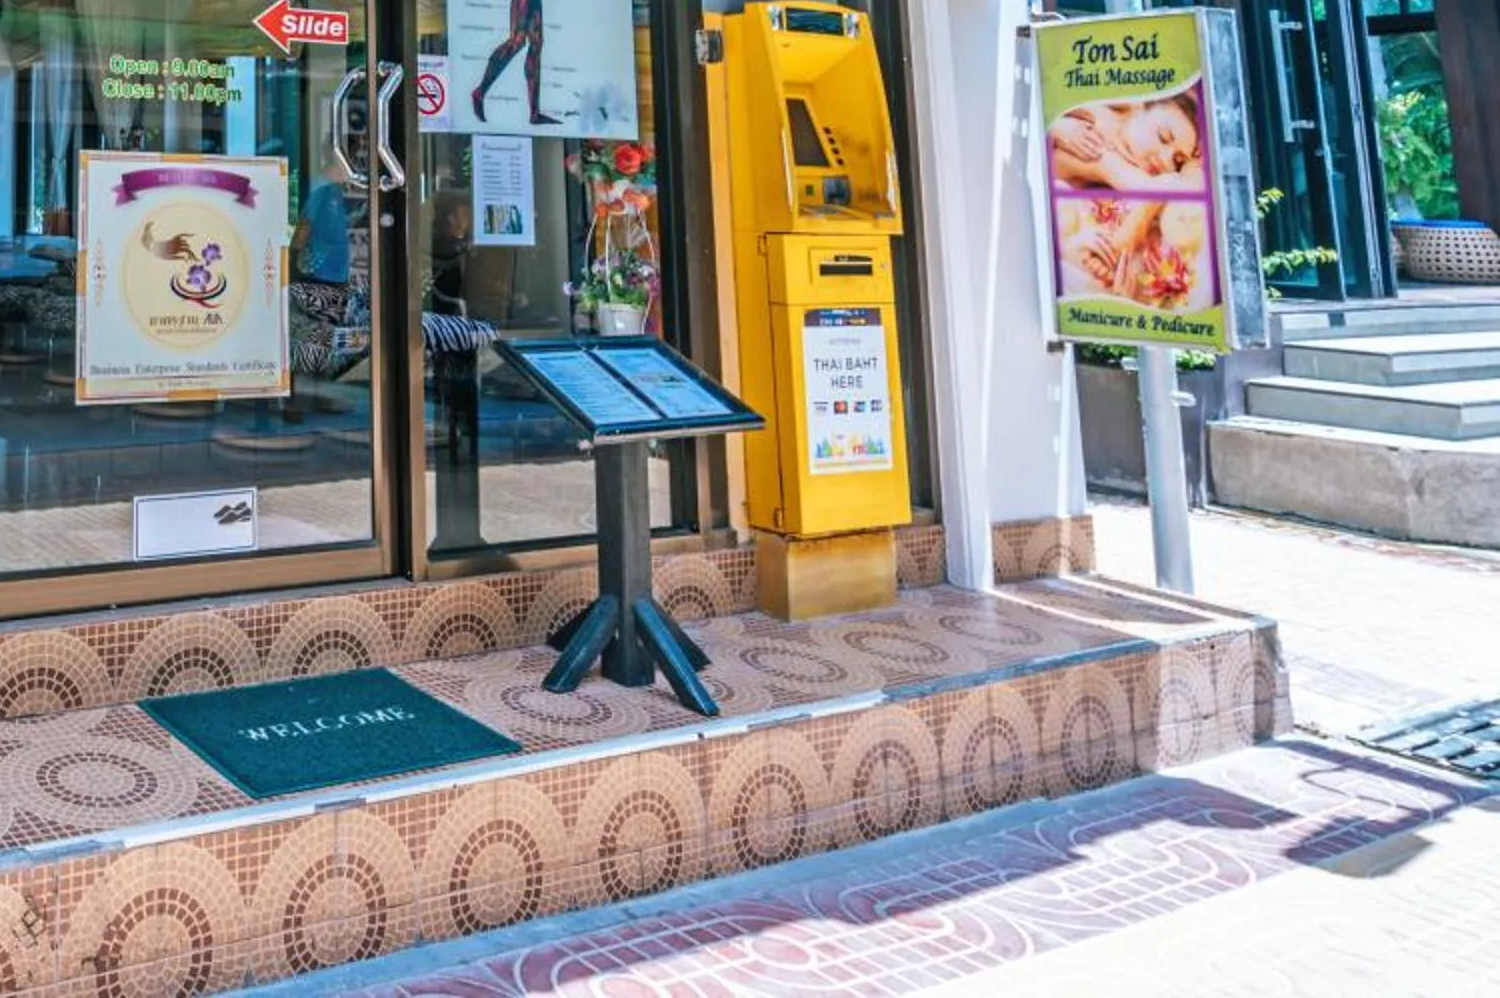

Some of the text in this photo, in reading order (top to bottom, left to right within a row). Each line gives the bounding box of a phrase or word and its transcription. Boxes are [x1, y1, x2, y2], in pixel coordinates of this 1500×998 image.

[1072, 33, 1161, 64] Ton Sai
[109, 55, 159, 77] Open
[102, 78, 155, 99] Close
[1064, 67, 1176, 90] Thai Massage
[1068, 307, 1216, 337] Manicure & Pedicure
[813, 357, 878, 372] THAI BAHT
[831, 375, 864, 389] HERE
[238, 707, 416, 742] WELCOME
